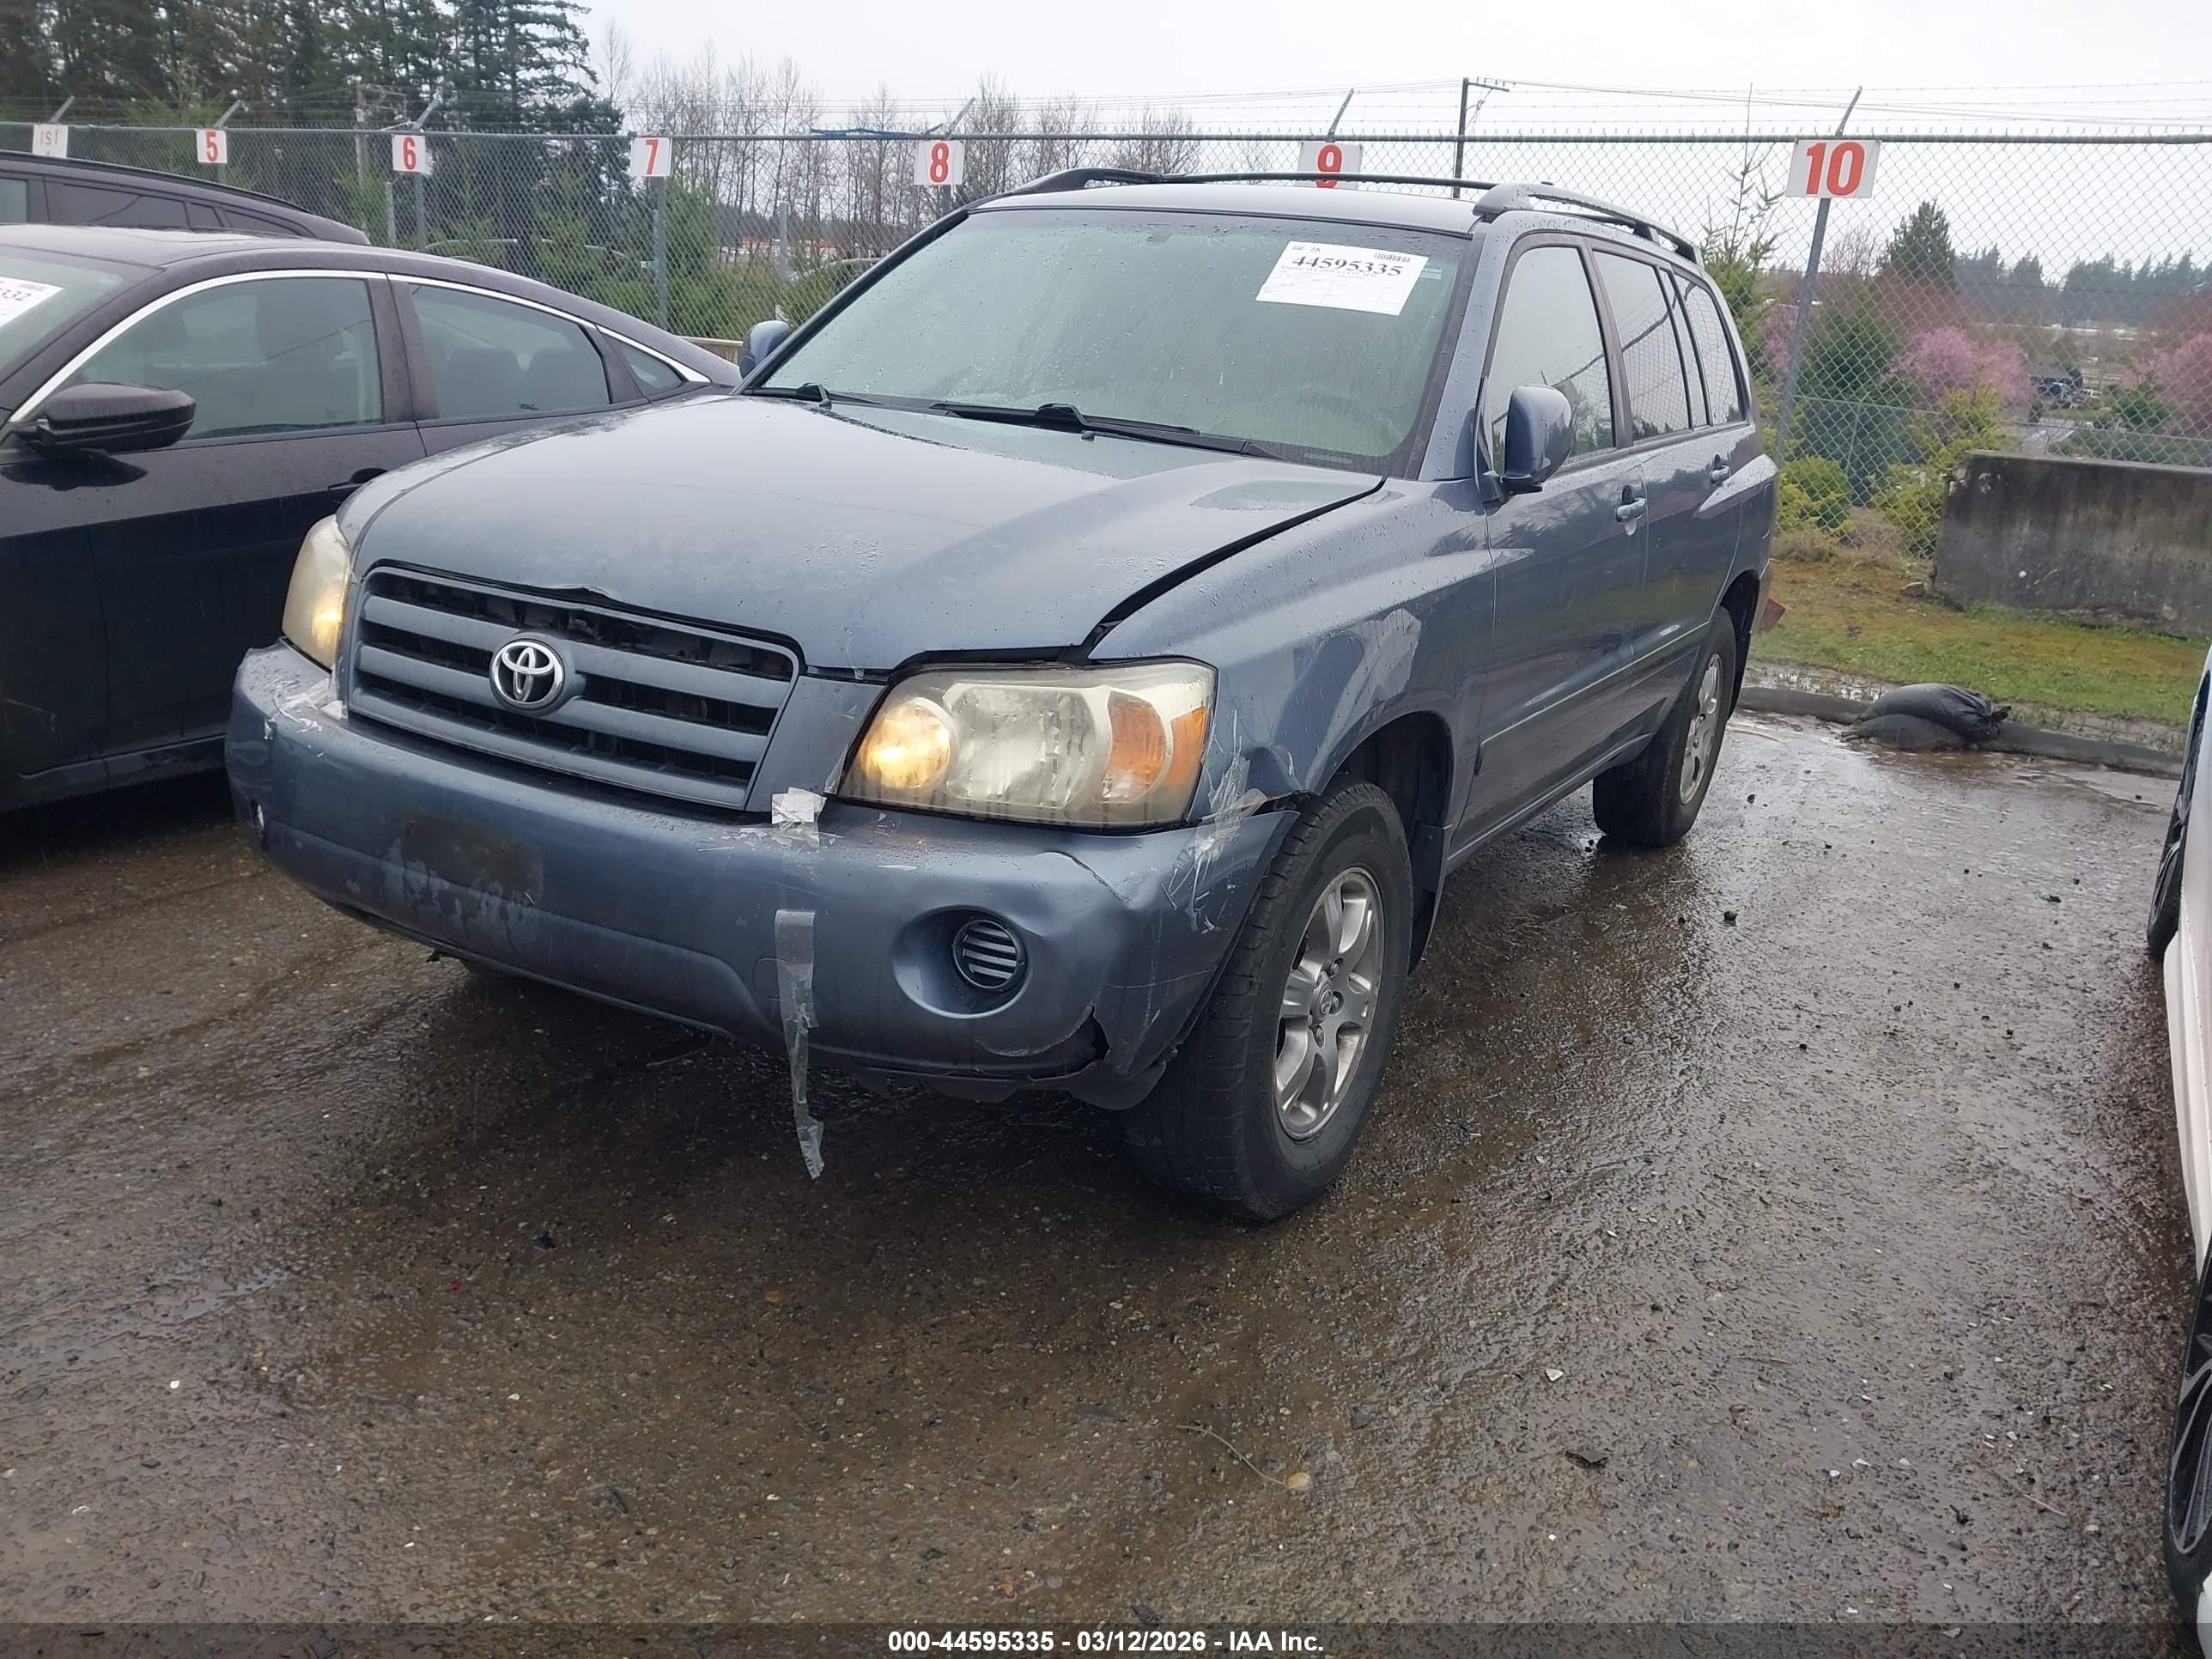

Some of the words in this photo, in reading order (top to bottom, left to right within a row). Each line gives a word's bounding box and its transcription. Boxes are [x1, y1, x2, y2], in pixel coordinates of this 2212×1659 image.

[206, 131, 218, 161] 5
[403, 137, 416, 170] 6
[645, 139, 659, 175] 7
[930, 143, 949, 183] 8
[1806, 142, 1865, 196] 10
[1291, 255, 1404, 276] 44595335
[0, 287, 32, 301] 332
